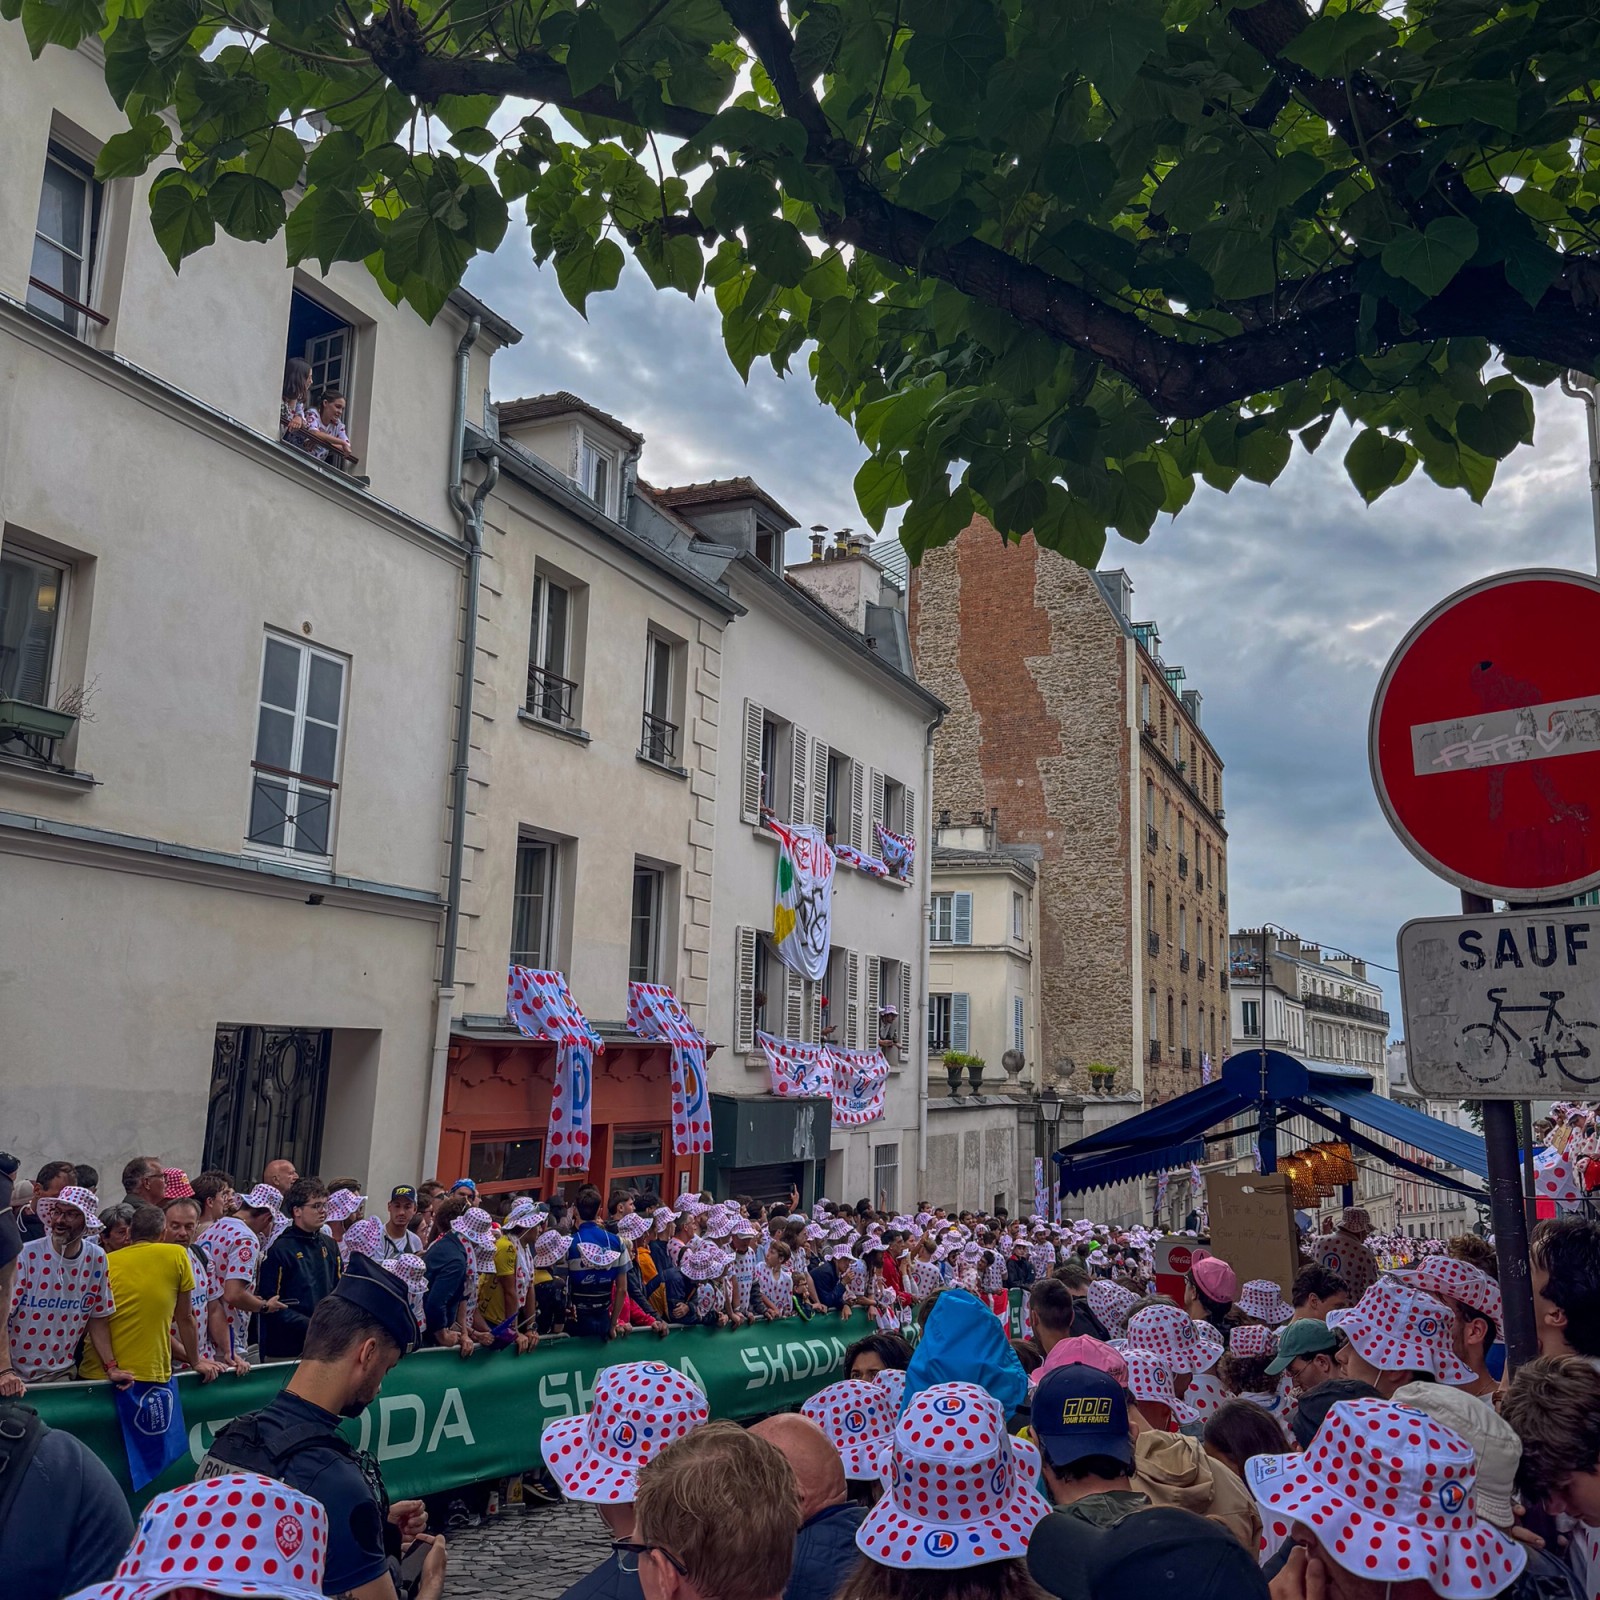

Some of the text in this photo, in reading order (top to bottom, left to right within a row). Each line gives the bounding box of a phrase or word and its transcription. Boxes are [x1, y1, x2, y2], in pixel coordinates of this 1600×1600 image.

[1457, 923, 1591, 971] SAUF
[1063, 1415, 1110, 1424] TOUR DE FRANCE
